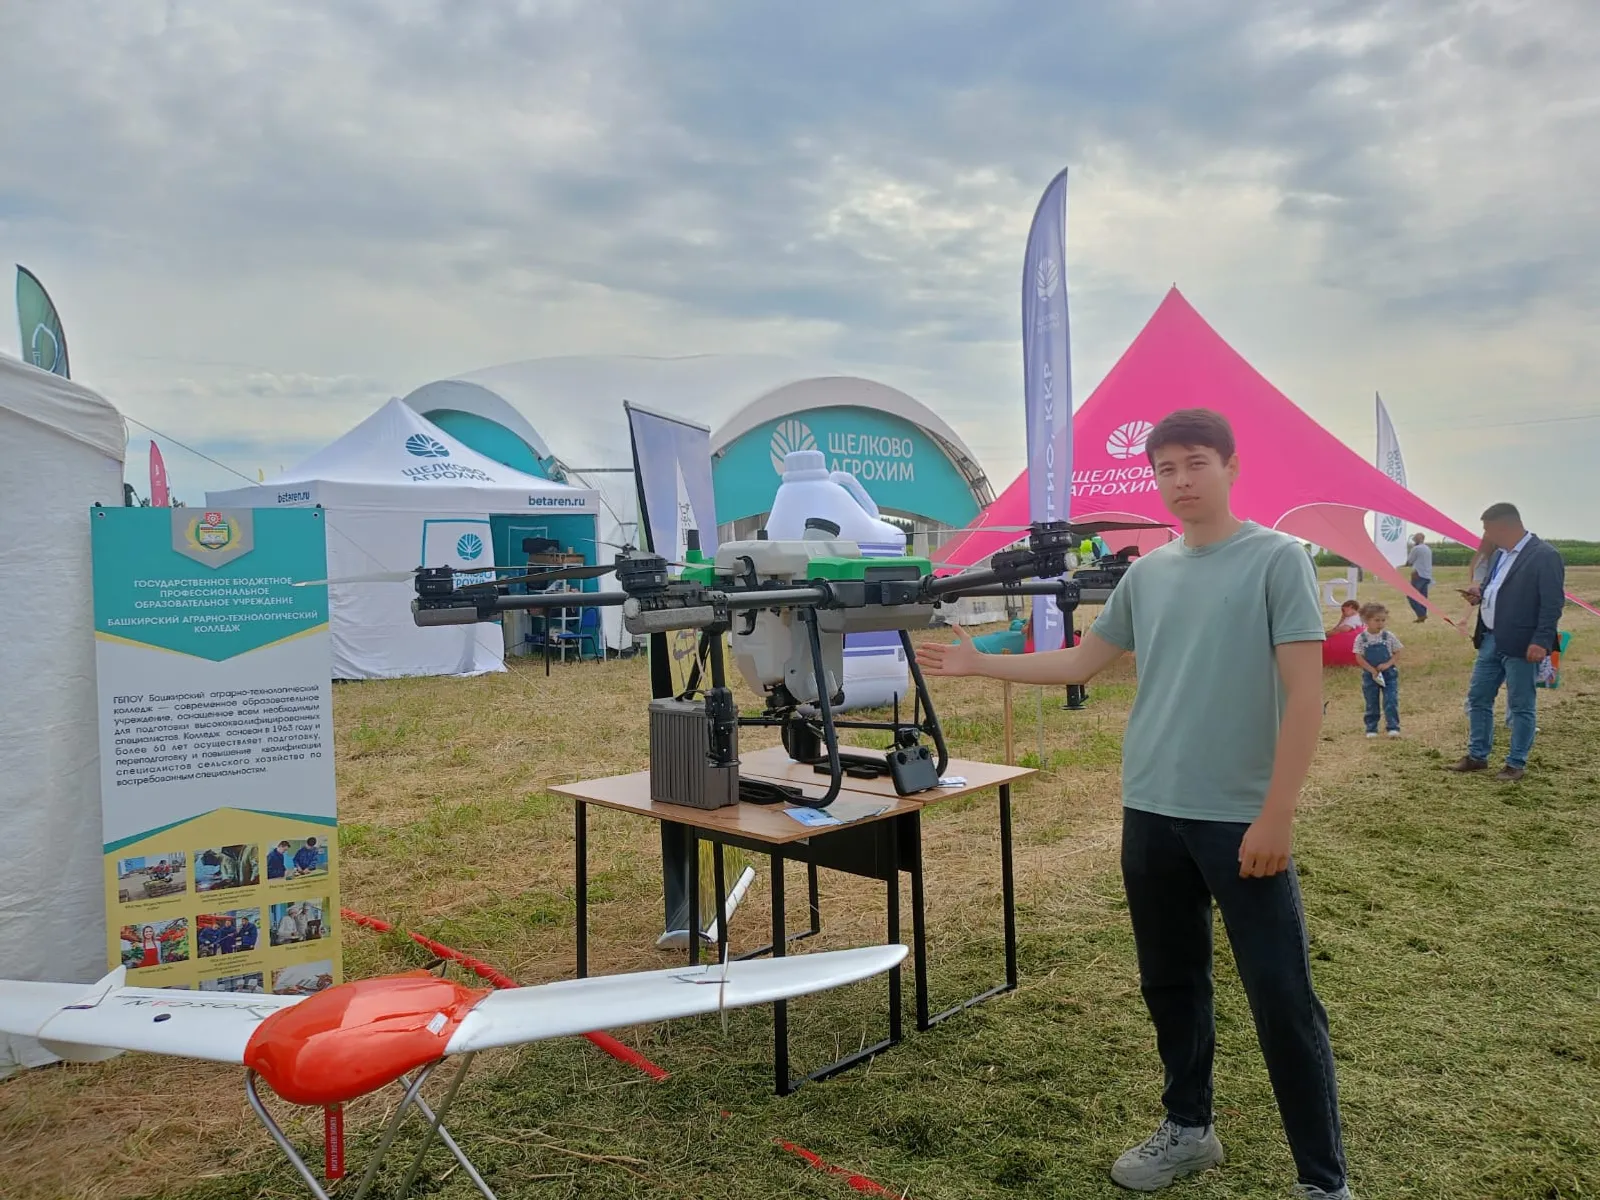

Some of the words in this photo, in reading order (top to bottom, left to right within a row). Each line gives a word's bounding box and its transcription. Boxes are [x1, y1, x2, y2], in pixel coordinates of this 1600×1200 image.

[828, 432, 913, 458] ЩЕЛКОВО
[401, 462, 487, 477] ЩЕЛКОВО
[412, 470, 497, 483] АГРОХИМ
[831, 458, 914, 481] АГРОХИМ
[1071, 465, 1155, 483] ЩЕЛКОВ
[277, 491, 310, 503] betaren.ru
[528, 494, 585, 506] betaren.ru
[134, 579, 230, 588] ГОСУДАРСТВЕННОЕ
[233, 577, 292, 587] БЮДЖЕТНОЕ
[160, 588, 270, 598] ПРОФЕССИОНАЛЬНОЕ
[134, 598, 229, 608] ОБРАЗОВАТЕЛЬНОЕ
[233, 596, 294, 606] УЧРЕЖДЕНИЕ
[108, 615, 180, 626] БАШКИРСКИЙ
[182, 610, 318, 624] АГРАРНО-ТЕХНОЛОГИЧЕСКИЙ
[194, 624, 240, 633] КОЛЛЕДЖ
[113, 695, 144, 704] ГБПОУ
[148, 691, 205, 702] Башкирский
[210, 684, 319, 698] аграрно-технологический
[114, 706, 154, 714] колледж
[174, 700, 237, 710] современное
[242, 694, 320, 706] образовательное
[263, 704, 320, 714] необходимым
[136, 724, 190, 734] подготовки
[194, 714, 320, 728] высококвалифицированных
[184, 731, 220, 740] Колледж
[226, 728, 262, 736] основан
[295, 724, 312, 732] году
[116, 747, 147, 756] более
[194, 738, 262, 749] осуществляет
[116, 754, 188, 766] переподготовку
[202, 748, 252, 758] повышение
[262, 743, 322, 753] квалификации
[116, 764, 192, 776] специалистов
[197, 758, 250, 768] сельского
[116, 774, 194, 786] востребованным
